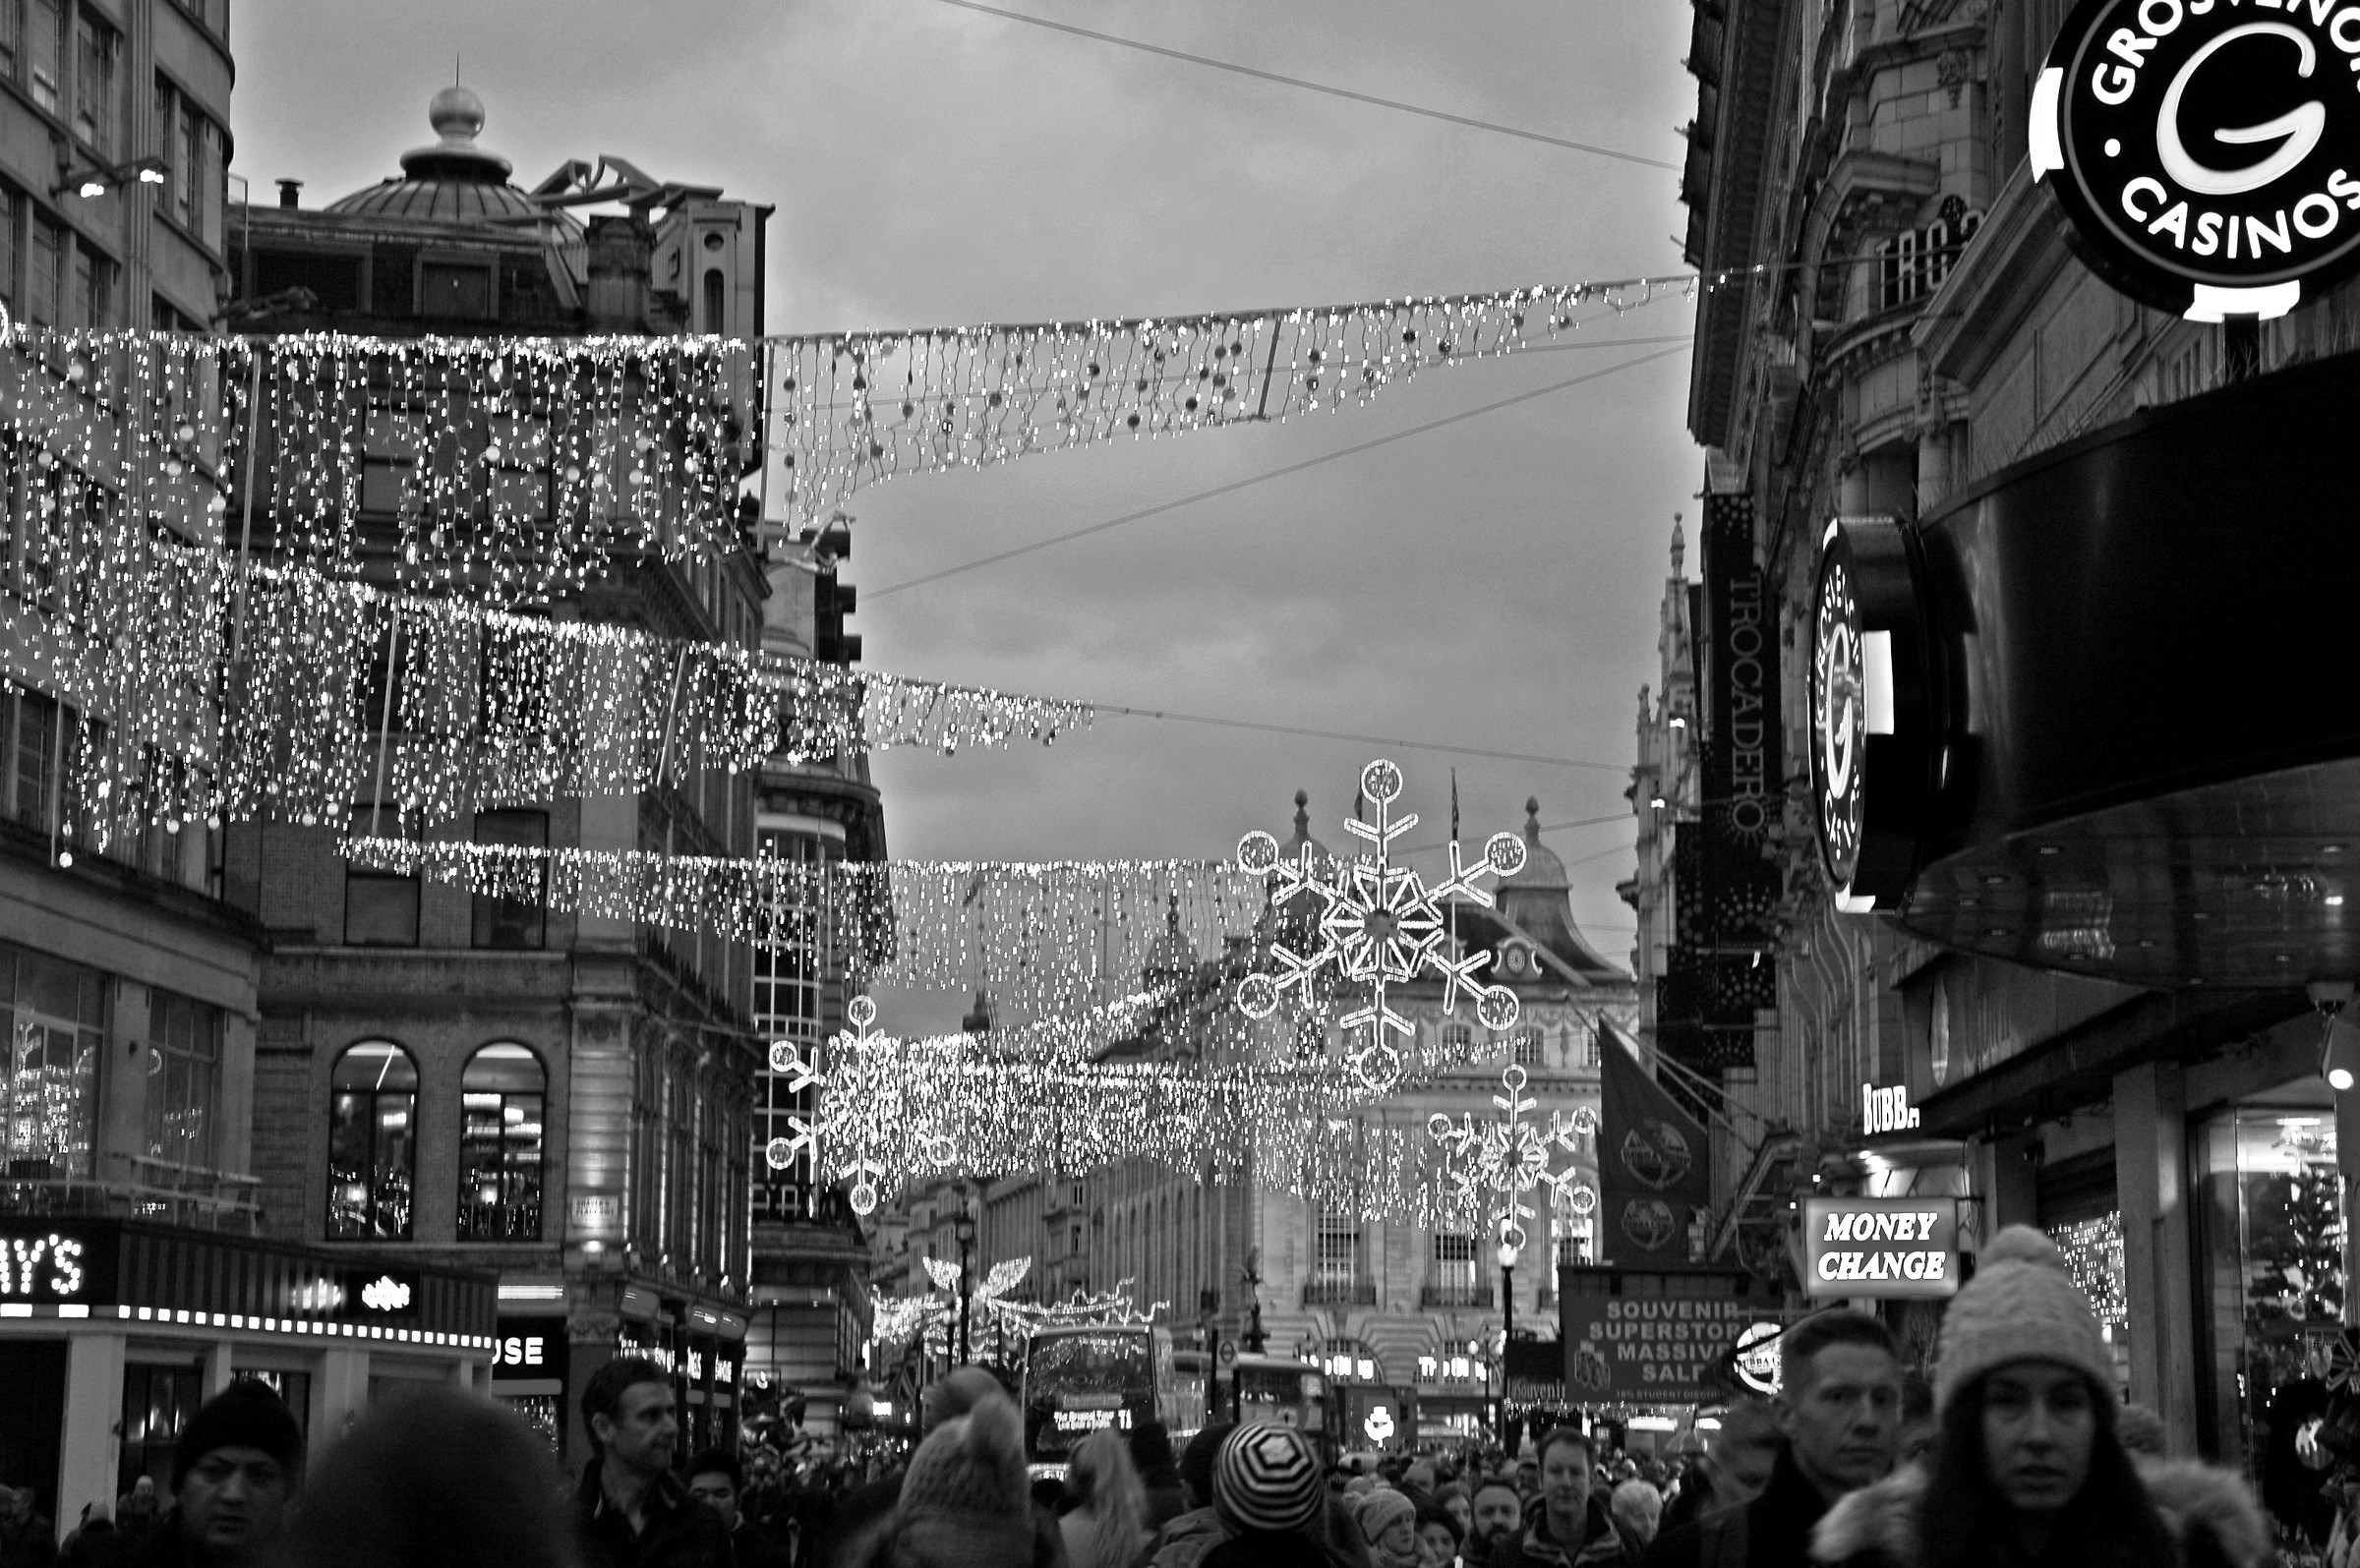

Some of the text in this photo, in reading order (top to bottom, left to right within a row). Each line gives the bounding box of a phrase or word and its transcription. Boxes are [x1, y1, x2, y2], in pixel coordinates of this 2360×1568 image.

[2121, 168, 2360, 260] CASINOS
[1730, 571, 1765, 833] TROCADERO
[1823, 1212, 1938, 1242] MONEY
[1817, 1250, 1946, 1281] CHANGE
[1607, 1301, 1740, 1320] SOUVENIR
